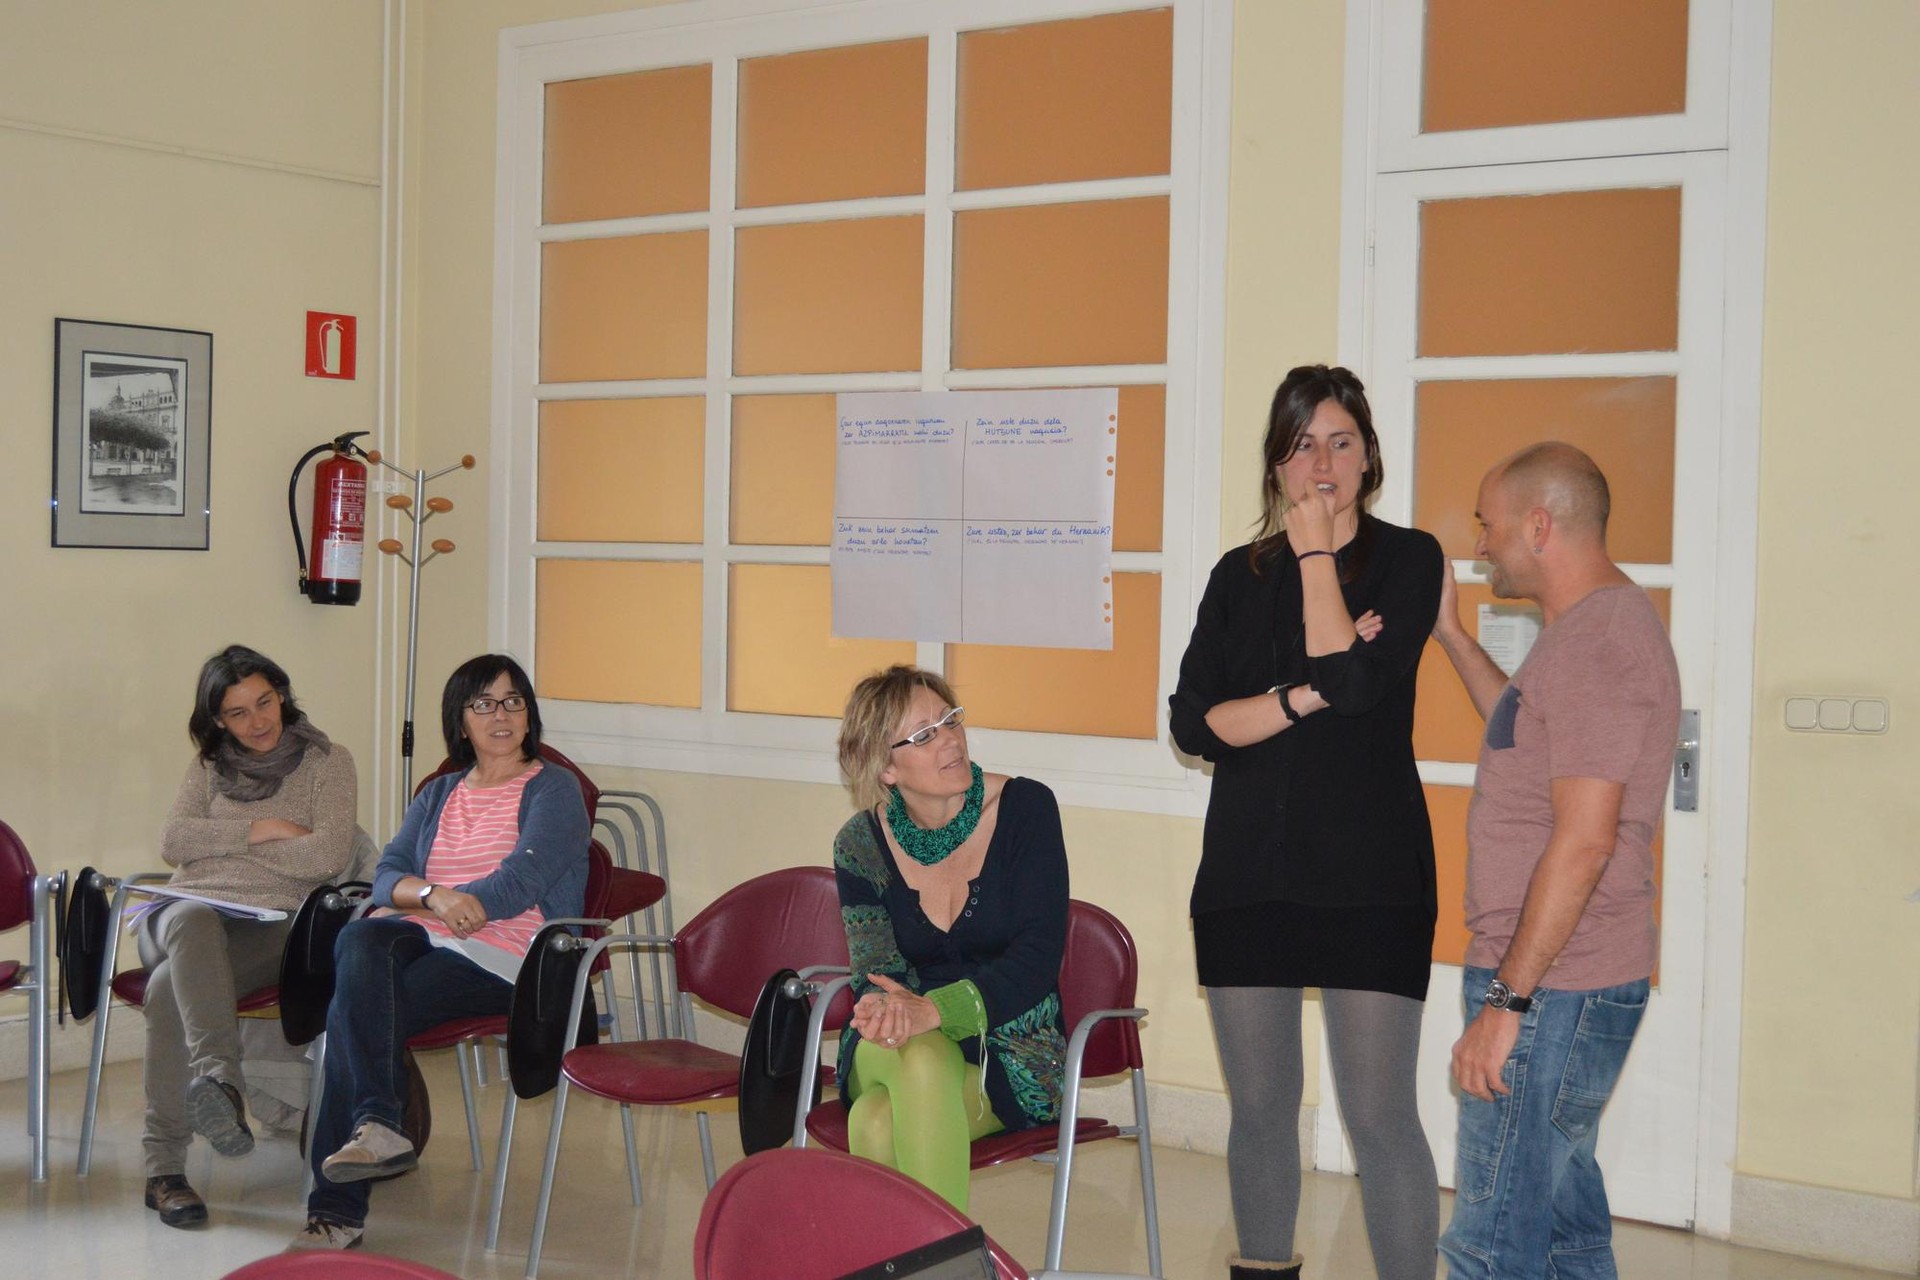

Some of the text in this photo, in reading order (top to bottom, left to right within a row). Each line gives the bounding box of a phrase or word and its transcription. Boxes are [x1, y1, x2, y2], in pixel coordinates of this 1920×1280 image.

[985, 428, 1022, 436] HUTSUNE
[1026, 527, 1046, 536] behar
[1051, 528, 1062, 536] du
